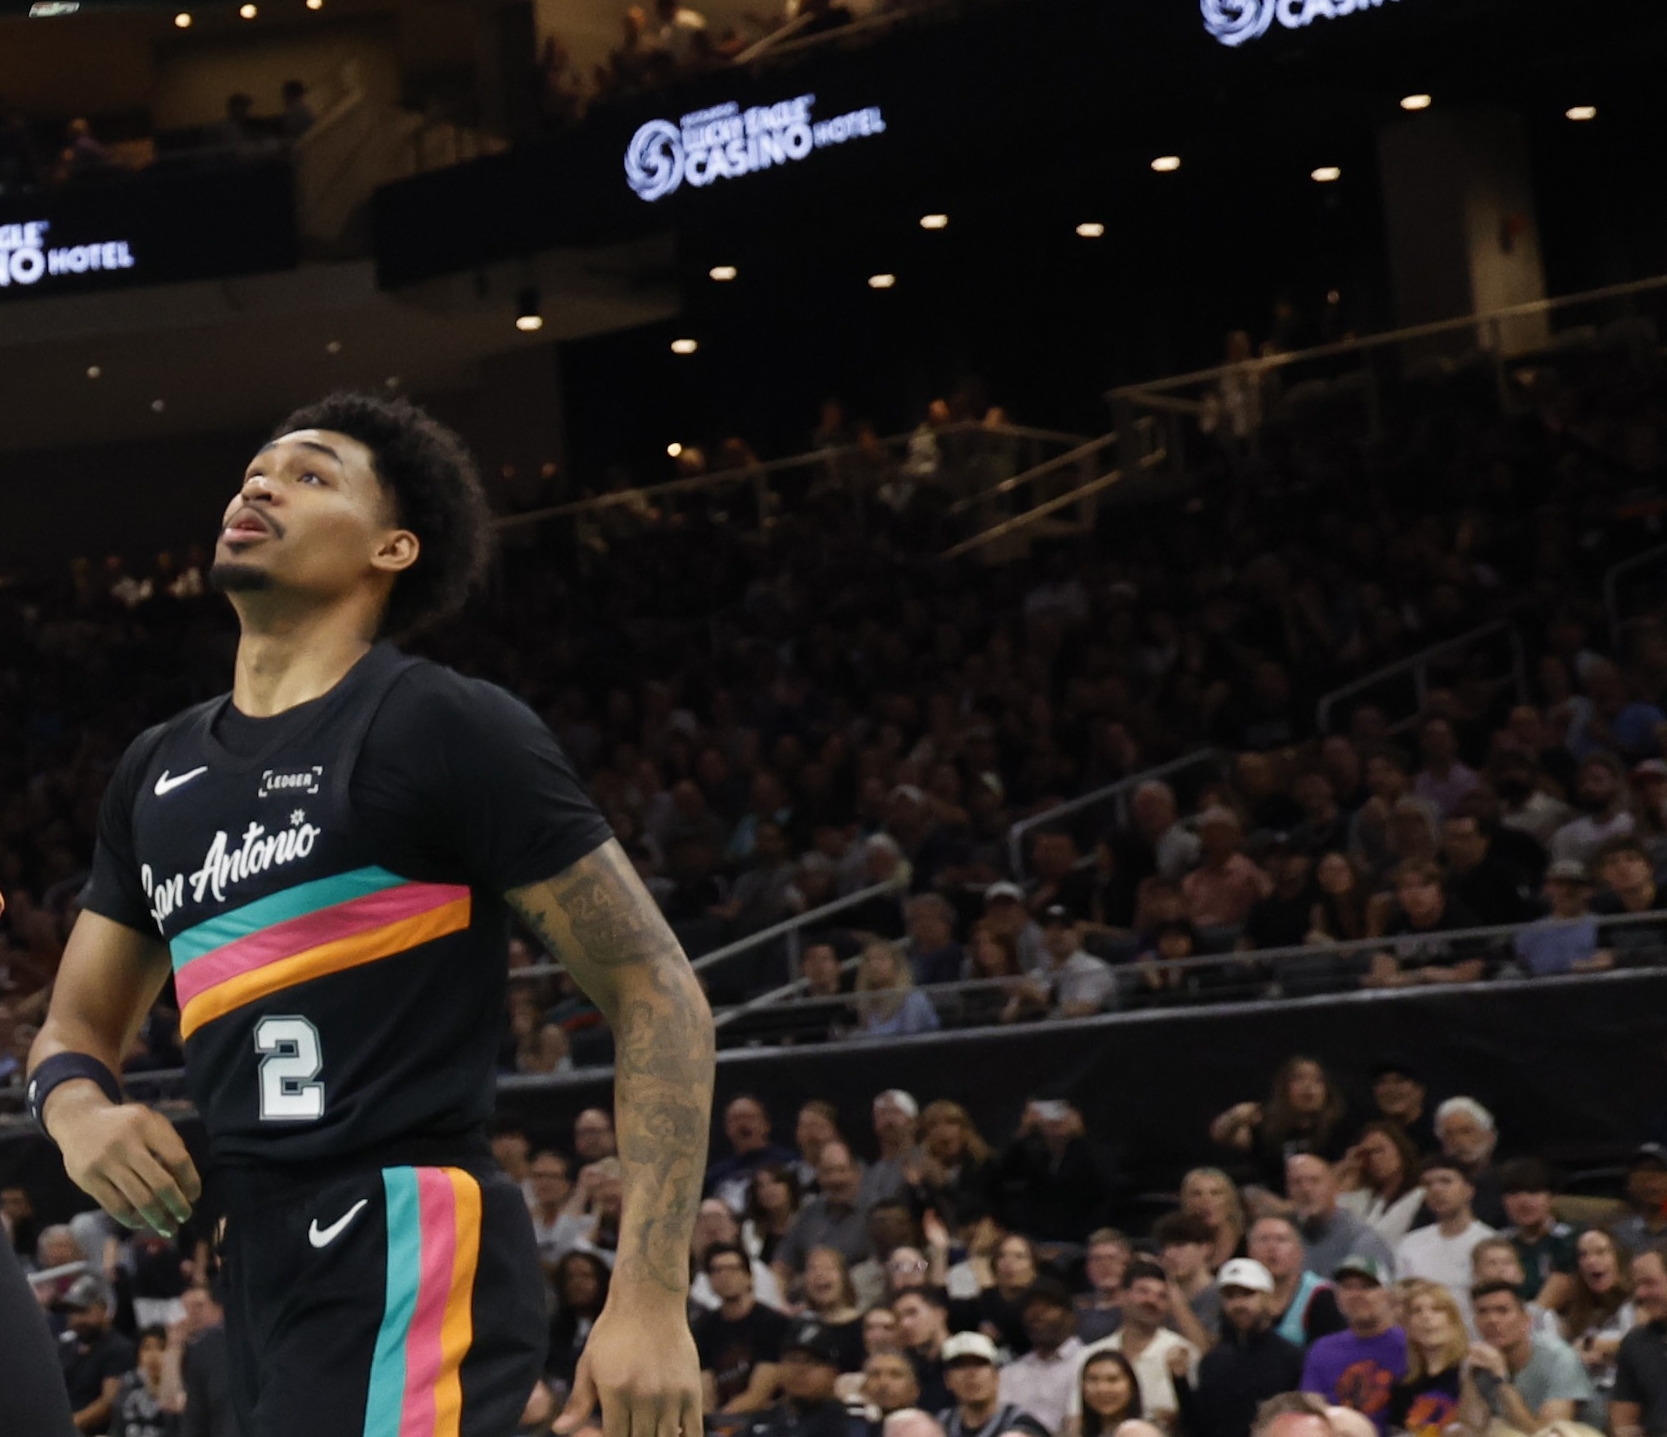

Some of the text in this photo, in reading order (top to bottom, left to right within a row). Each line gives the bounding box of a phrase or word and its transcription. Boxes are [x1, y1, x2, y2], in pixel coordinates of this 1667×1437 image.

[683, 122, 813, 187] CASINO
[47, 241, 135, 276] HOTEL
[267, 773, 313, 790] LEDGER
[188, 808, 322, 904] Antonio
[253, 1013, 325, 1121] 2
